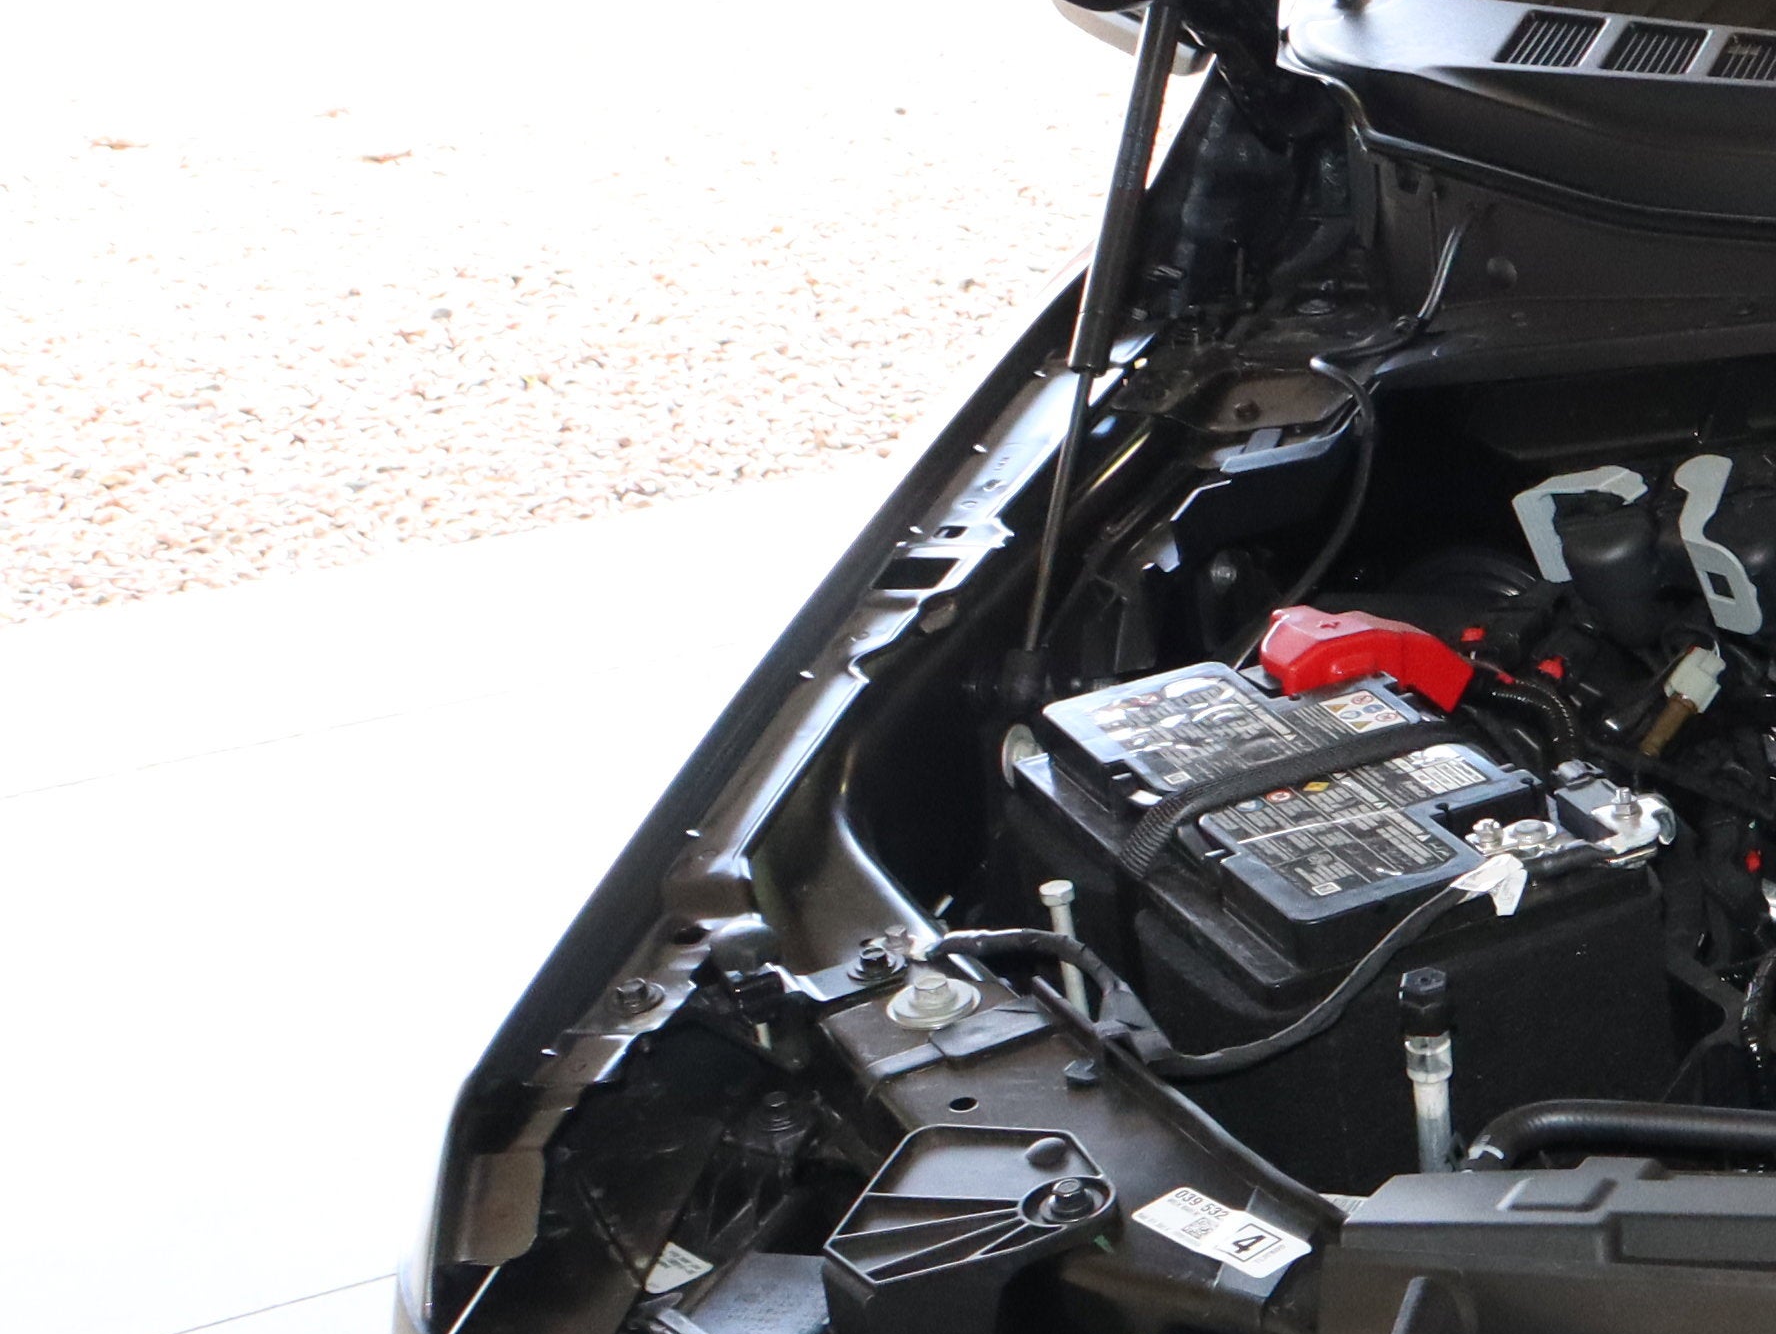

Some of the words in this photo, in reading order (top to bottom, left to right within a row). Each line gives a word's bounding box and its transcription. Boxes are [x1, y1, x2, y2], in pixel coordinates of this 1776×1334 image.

[1174, 1189, 1203, 1208] 039
[1200, 1201, 1231, 1219] 532
[1232, 1233, 1266, 1255] 4
